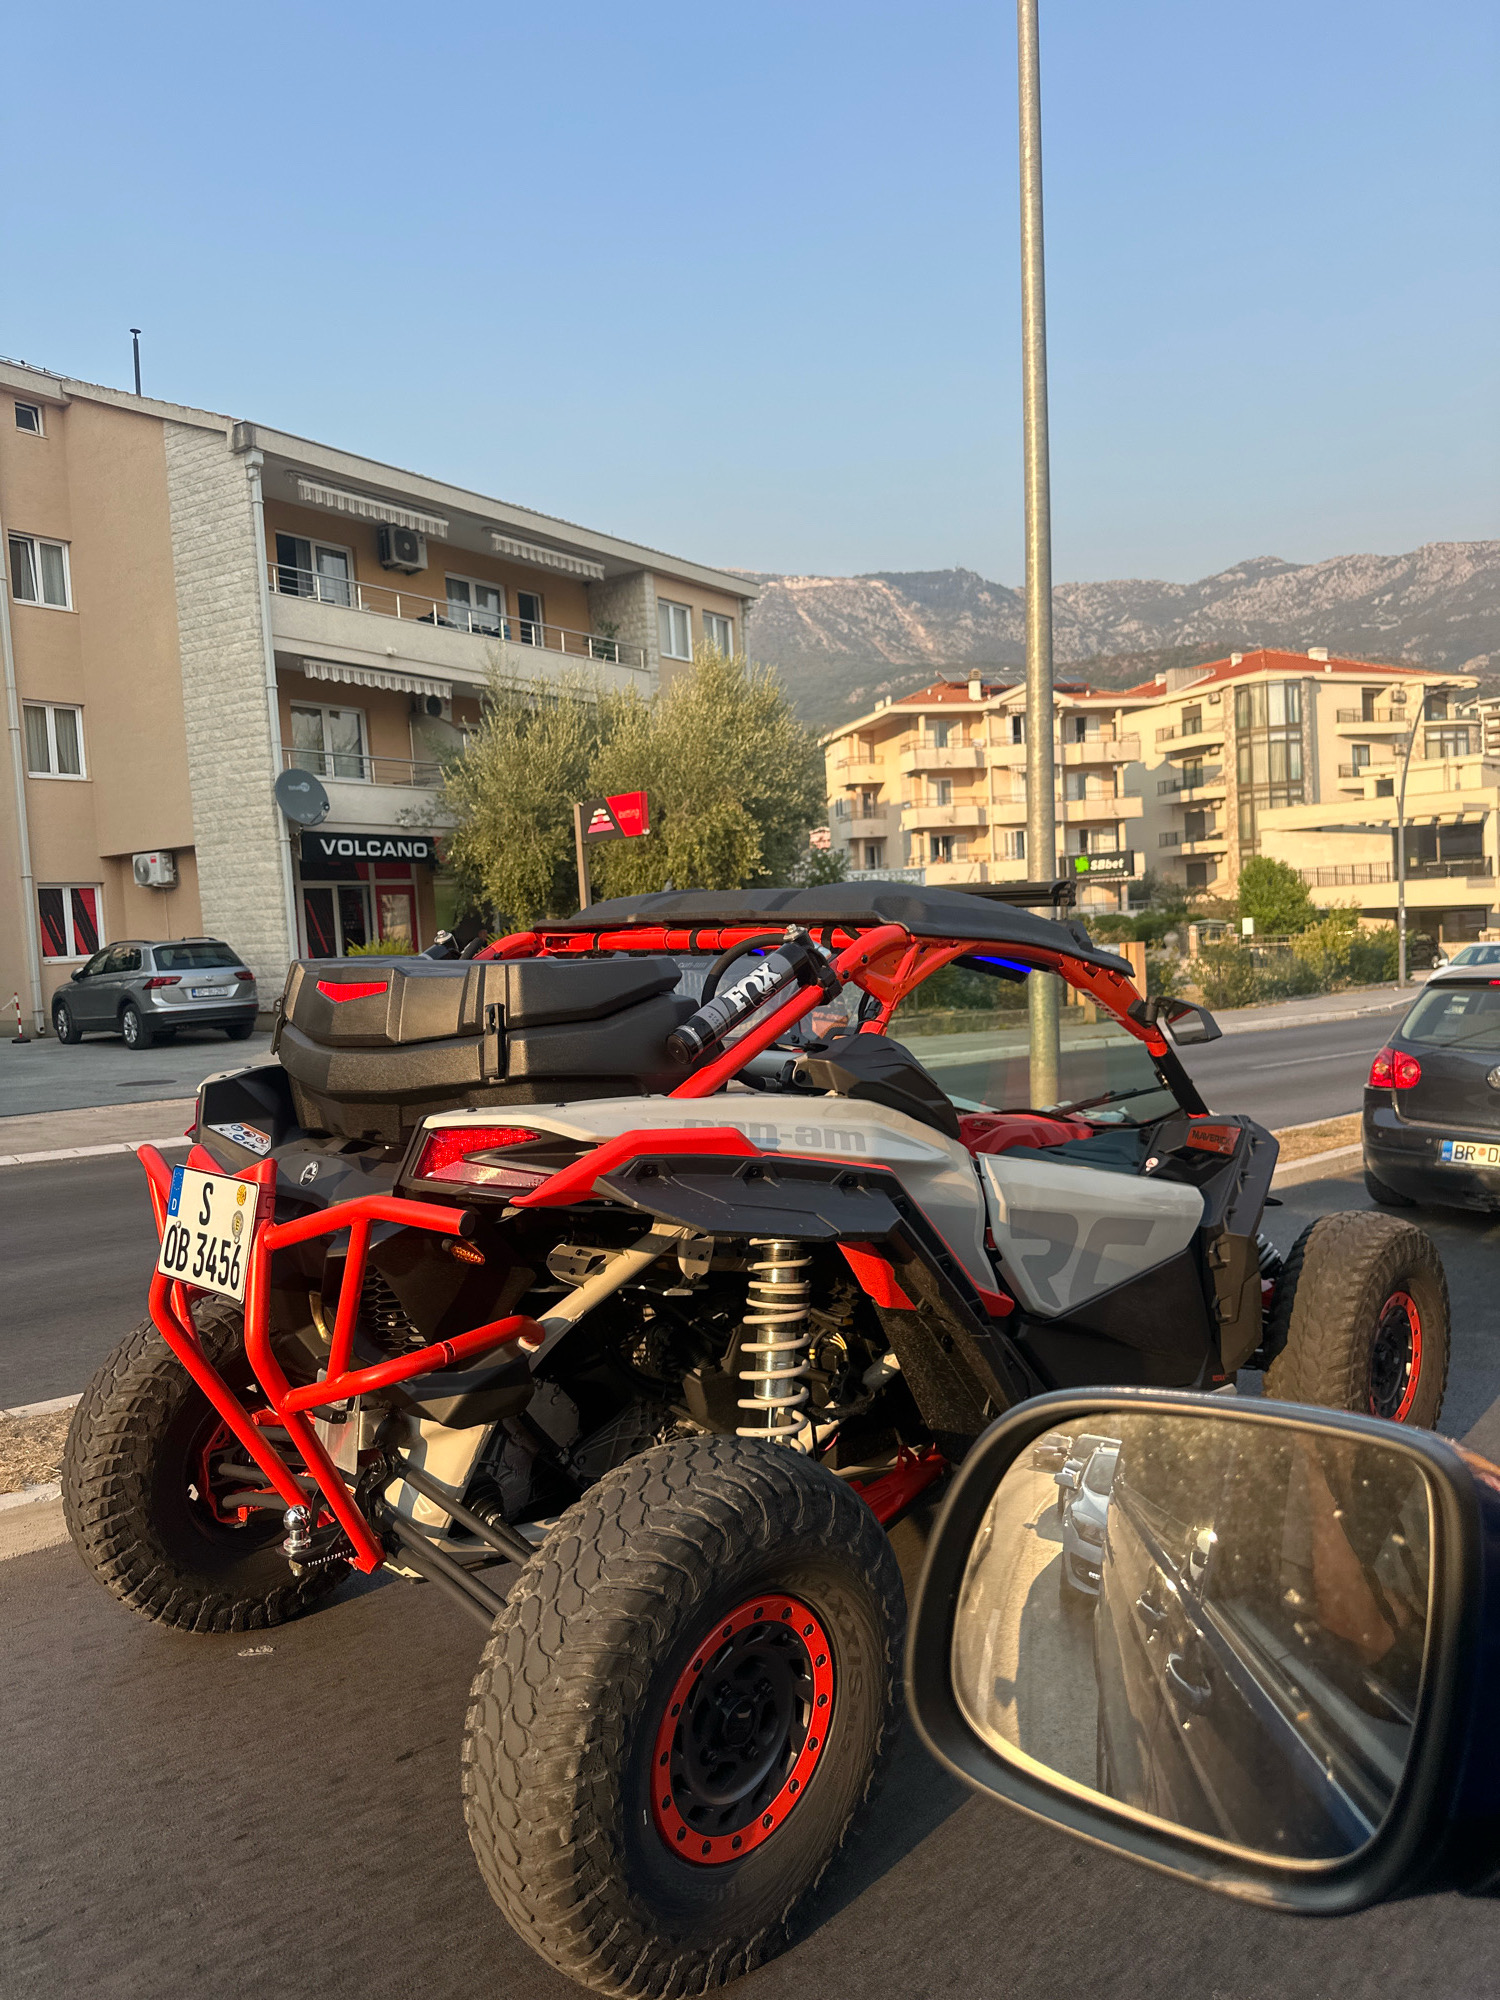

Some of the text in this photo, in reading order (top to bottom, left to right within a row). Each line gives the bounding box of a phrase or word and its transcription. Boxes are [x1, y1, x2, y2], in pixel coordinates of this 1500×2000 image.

[320, 839, 428, 858] VOLCANO
[722, 962, 782, 1012] FOX
[1454, 1144, 1476, 1160] BR
[171, 1198, 177, 1210] D
[199, 1182, 214, 1226] S
[164, 1224, 241, 1290] OB 3456
